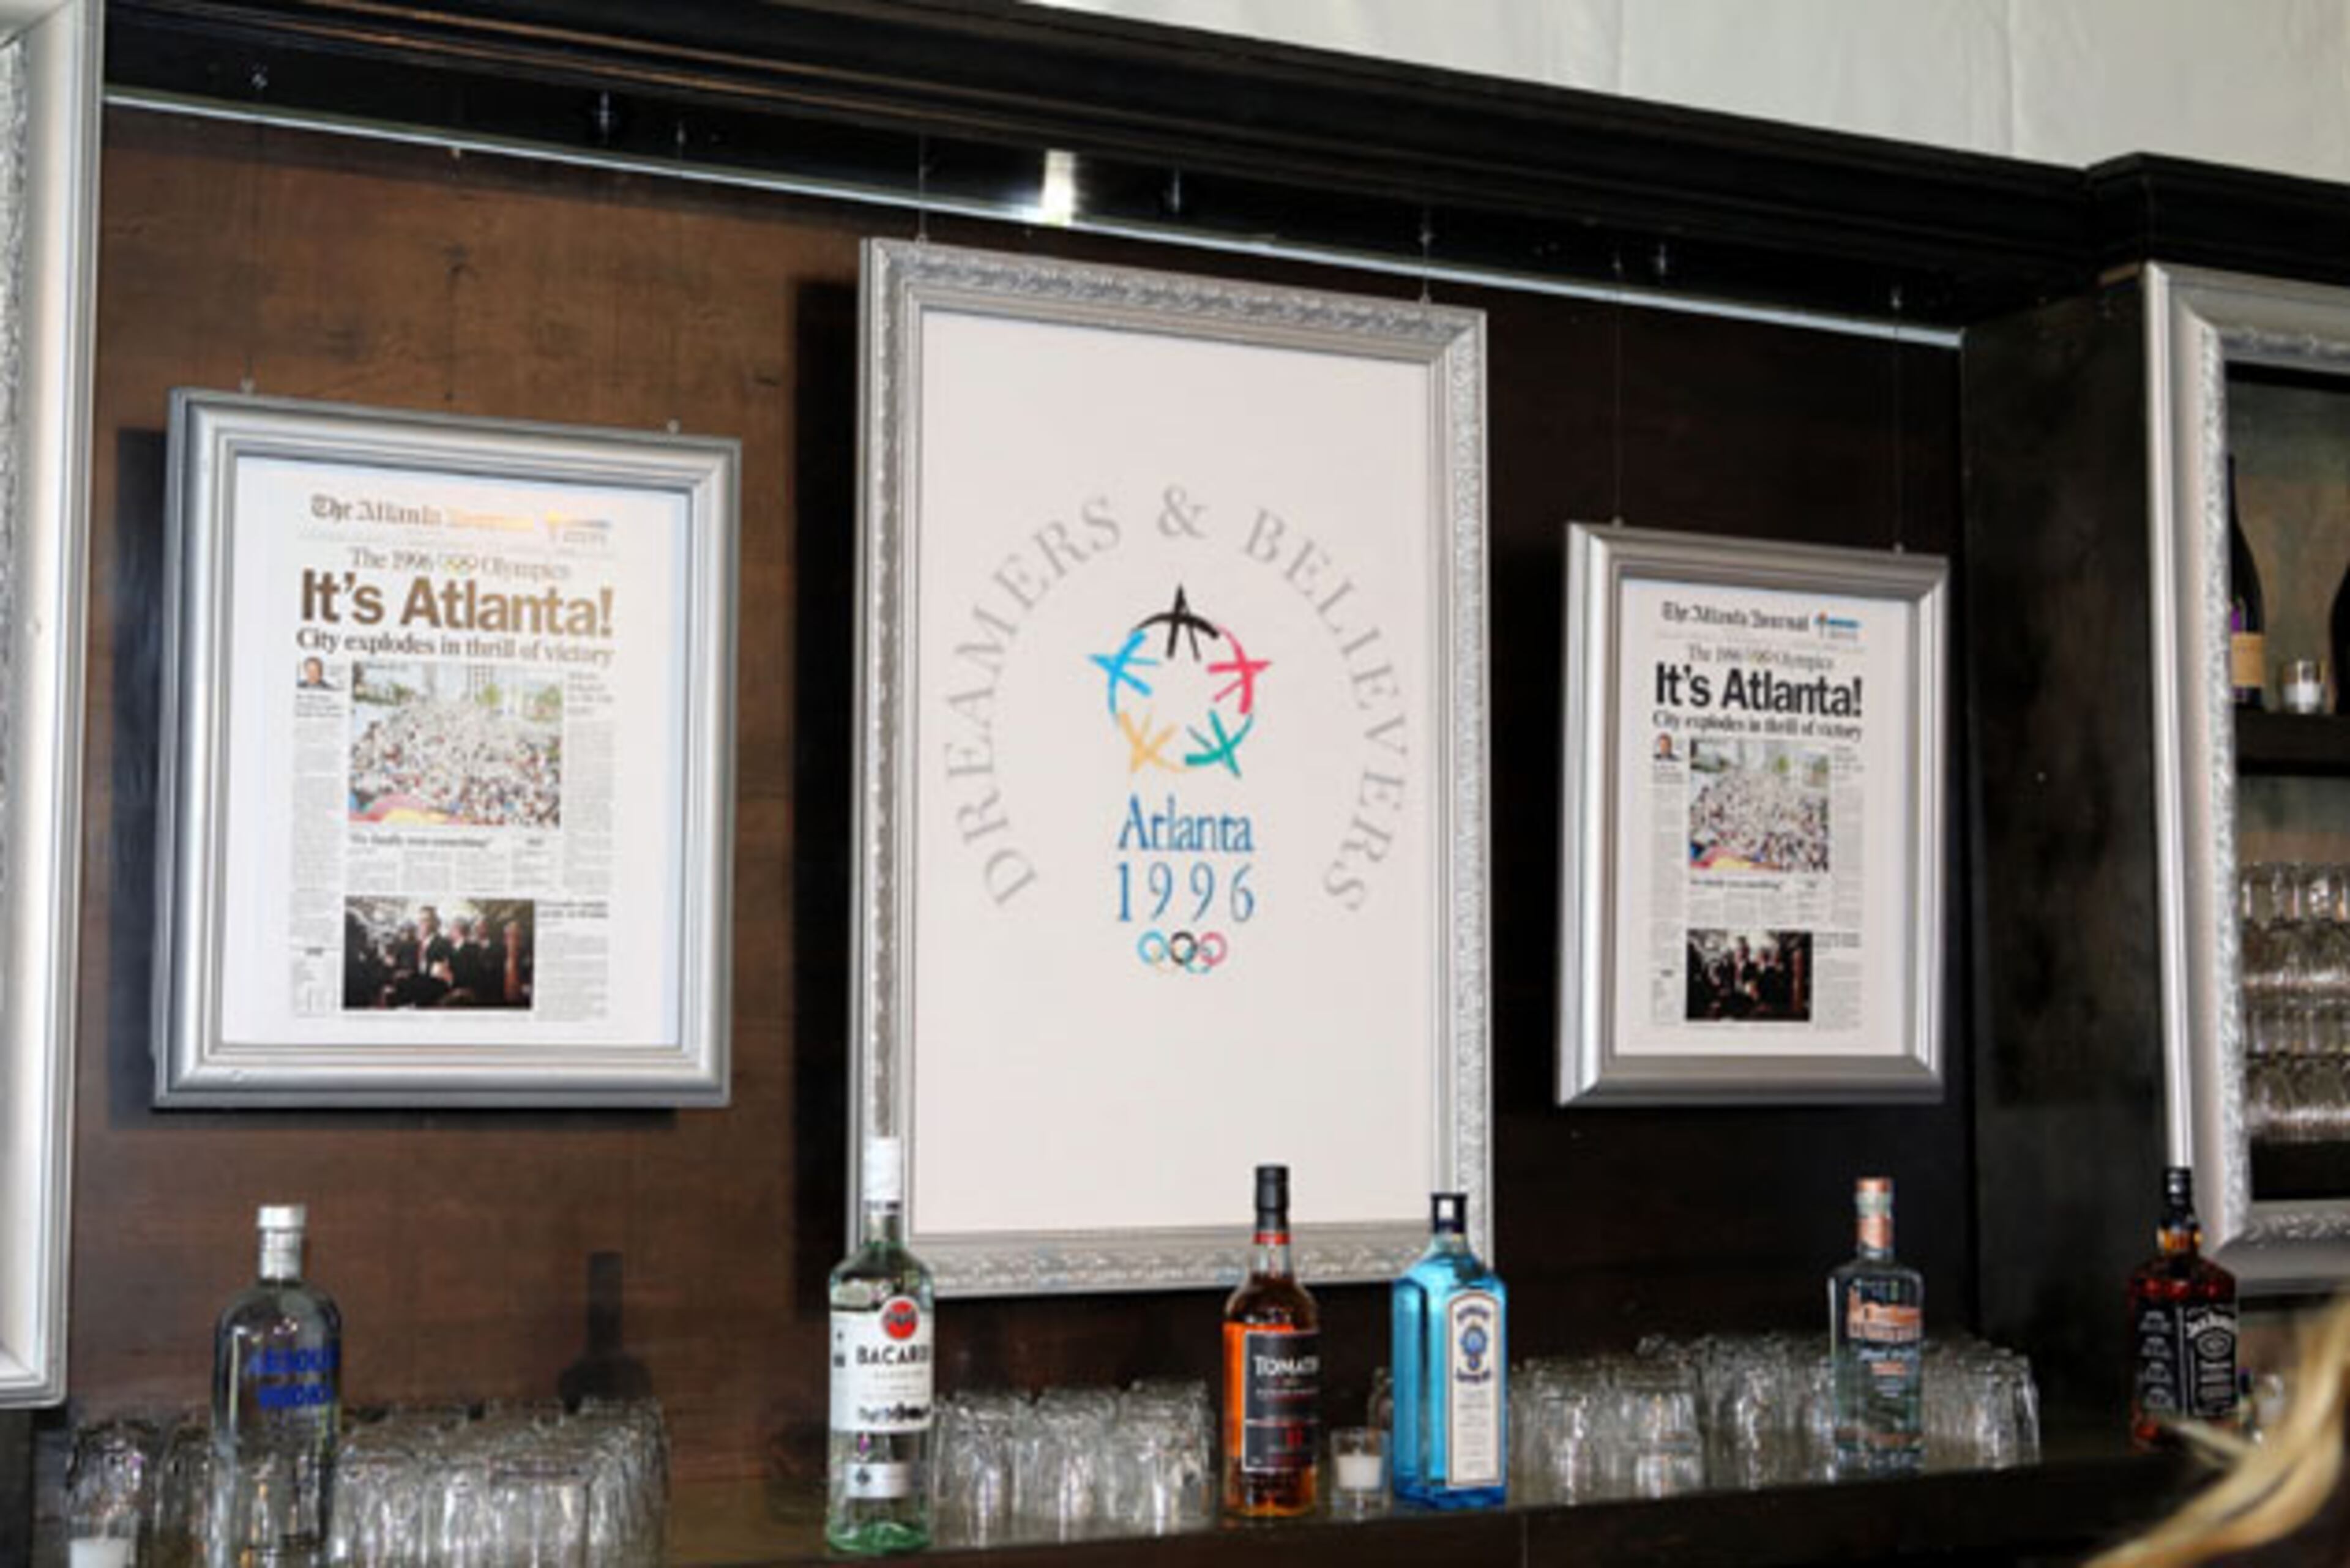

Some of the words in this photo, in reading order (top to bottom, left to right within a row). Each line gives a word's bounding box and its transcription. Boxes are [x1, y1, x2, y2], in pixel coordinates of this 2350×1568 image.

[311, 493, 352, 522] The
[302, 568, 386, 625] It's
[400, 576, 613, 638] Atlanta!
[296, 627, 340, 654] City
[345, 632, 435, 657] explodes
[440, 634, 461, 655] in
[466, 637, 517, 659] thrill
[519, 640, 542, 661] of
[543, 642, 616, 669] victory
[944, 495, 1121, 907] DREAMERS
[1157, 485, 1212, 540] &
[1244, 507, 1409, 912] BELIEVERS
[1656, 662, 1712, 707] It's
[1720, 668, 1862, 718] Atlanta!
[1652, 710, 1681, 730] City
[1685, 715, 1744, 734] explodes
[1117, 792, 1255, 852] Atlanta
[1117, 861, 1256, 924] 1996
